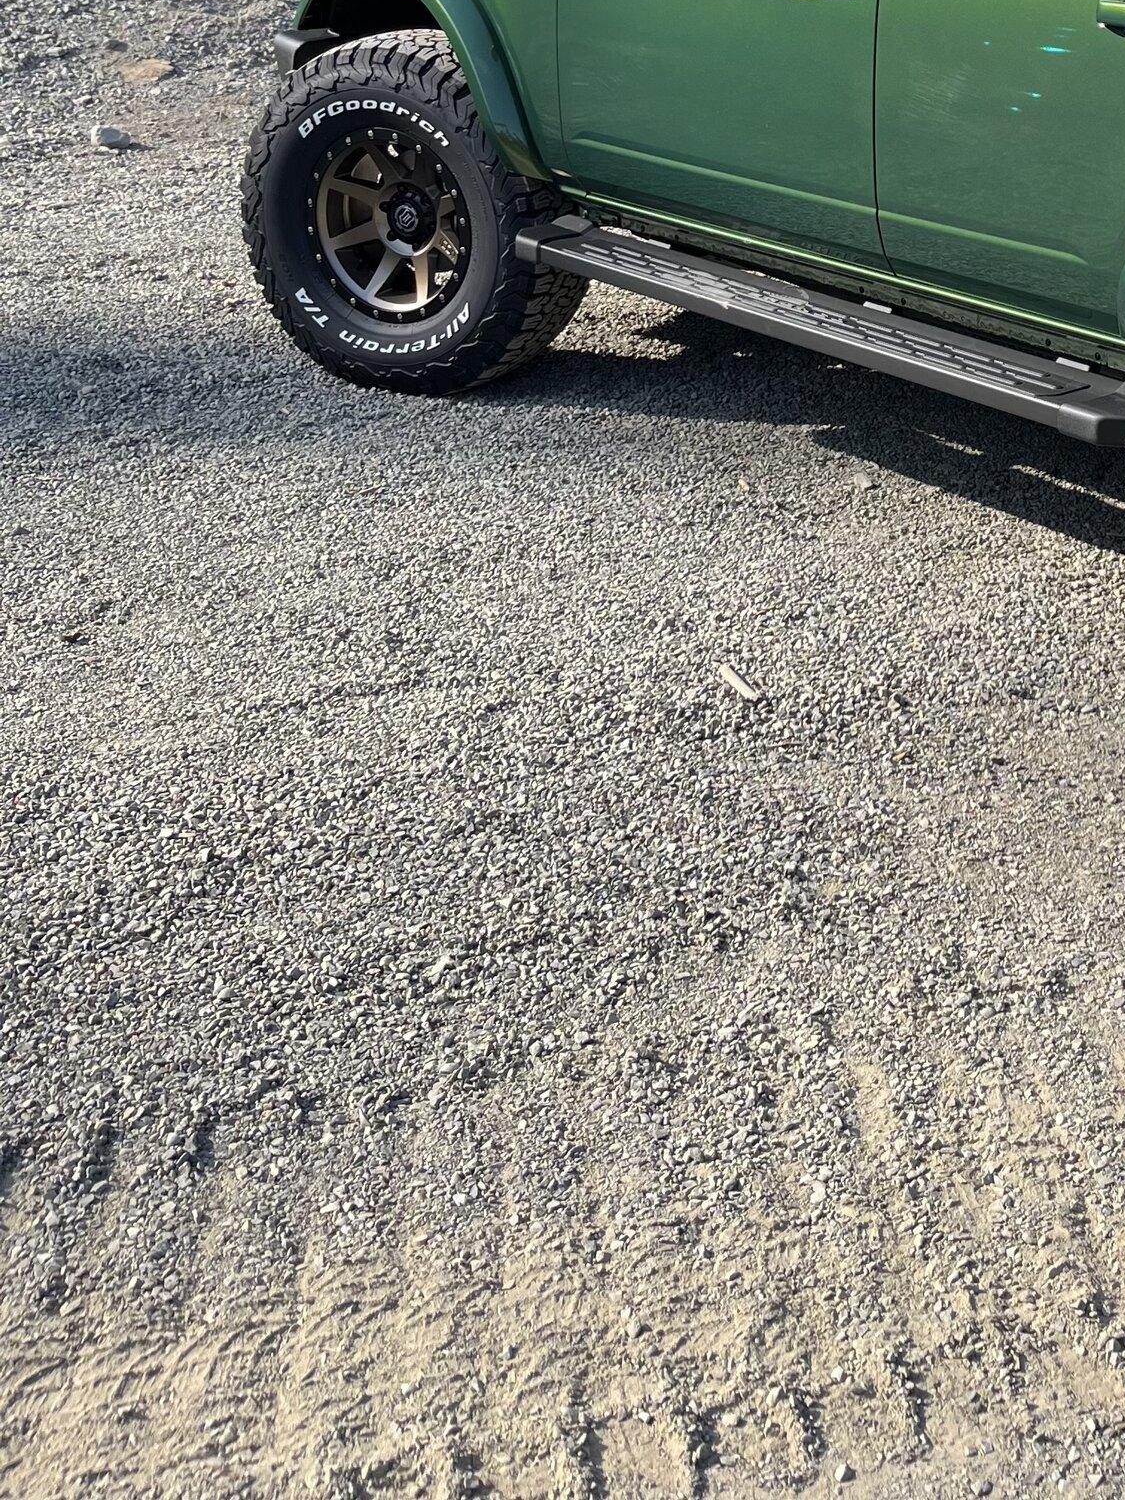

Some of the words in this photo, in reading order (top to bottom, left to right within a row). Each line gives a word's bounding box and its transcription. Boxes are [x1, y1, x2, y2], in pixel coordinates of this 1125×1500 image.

[298, 99, 450, 147] BFGoodrich
[294, 287, 330, 328] T/A
[338, 302, 471, 354] All-Terrain
